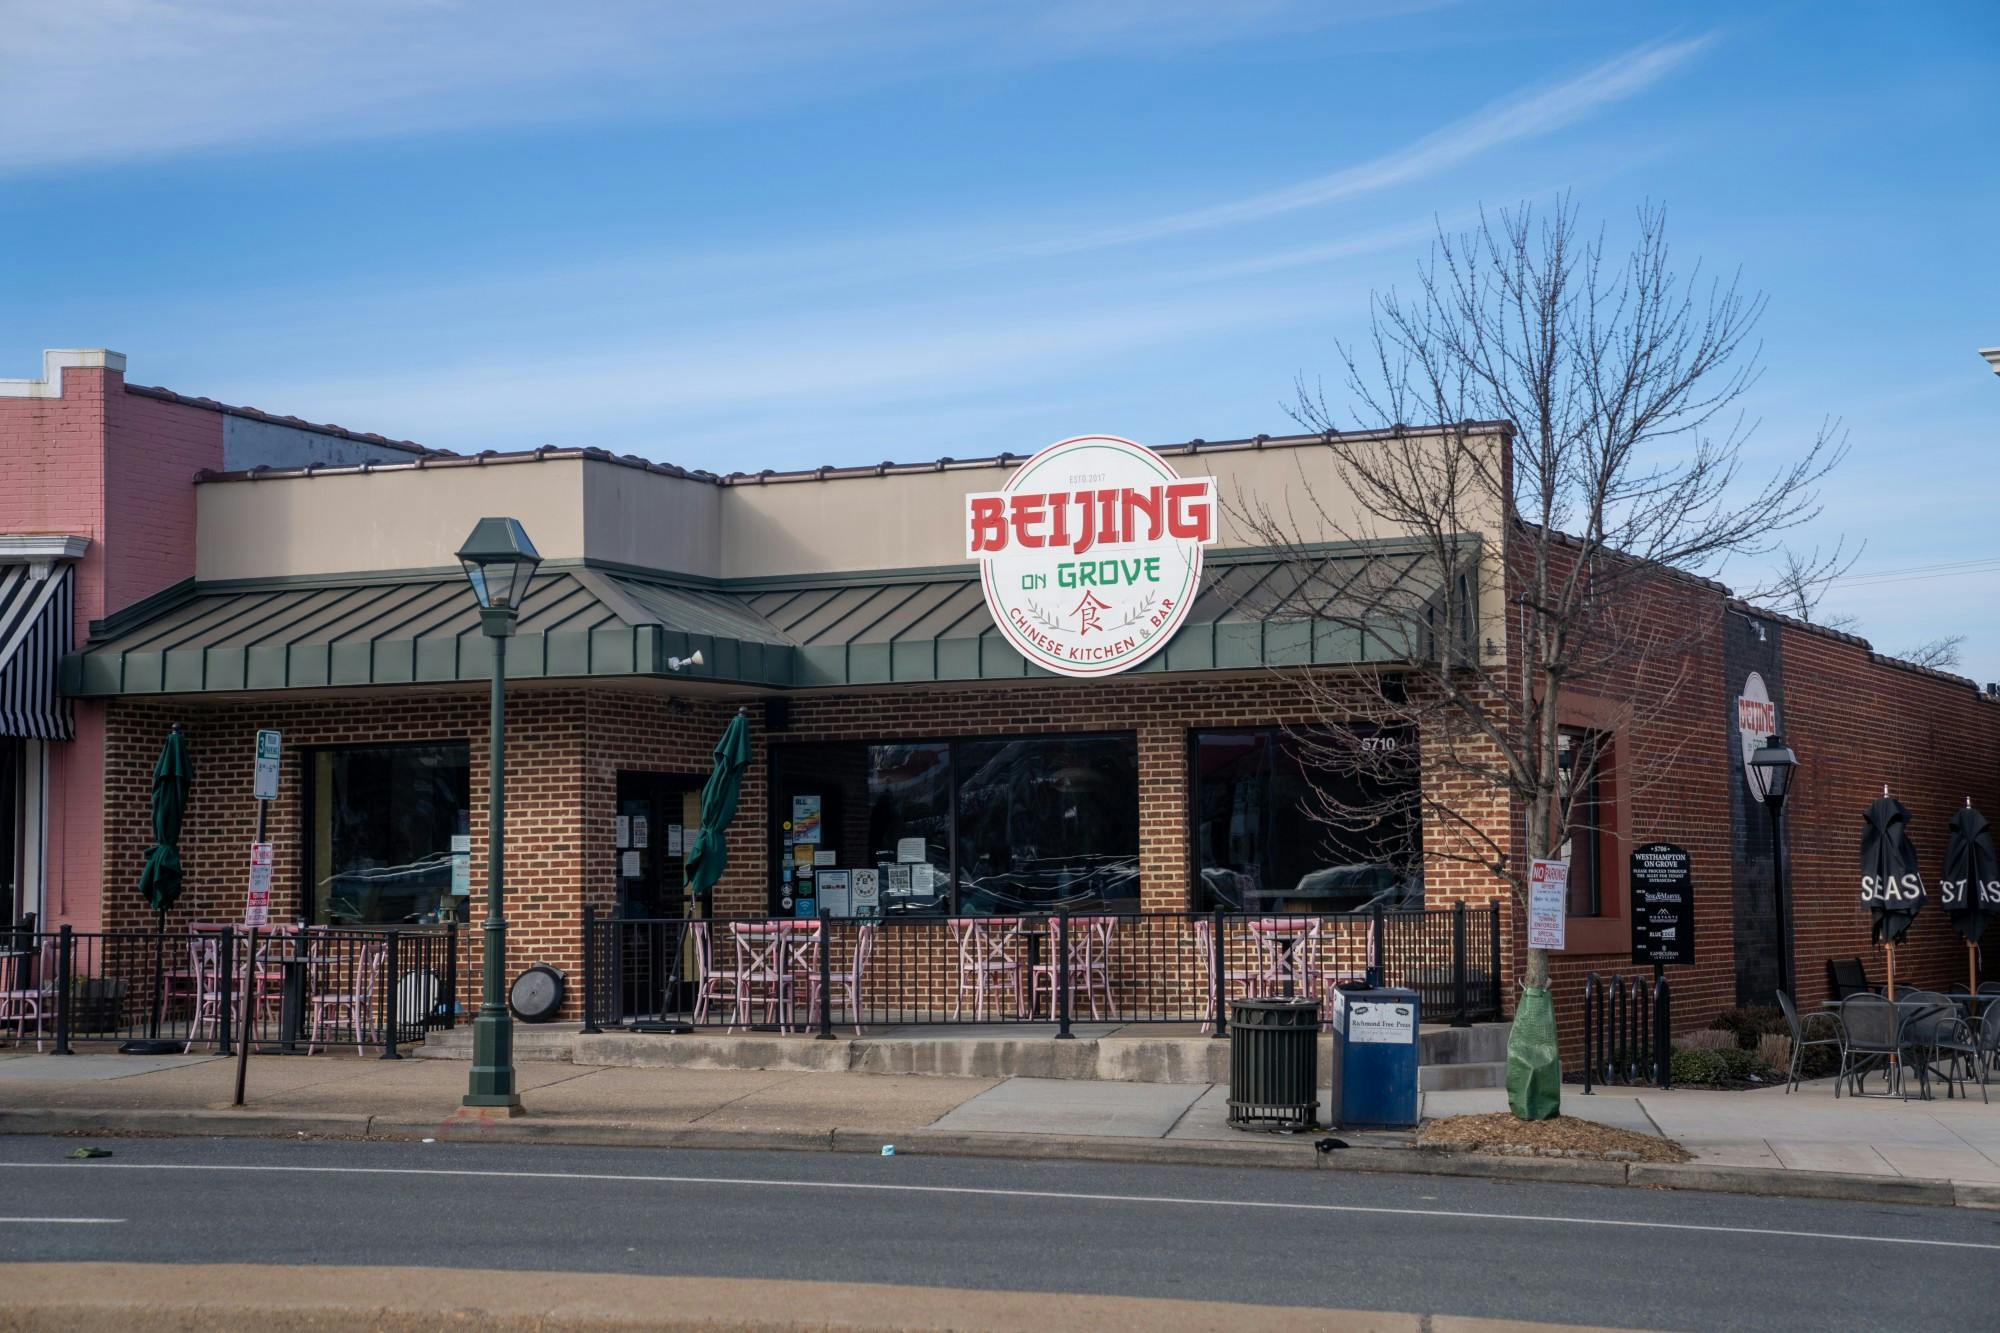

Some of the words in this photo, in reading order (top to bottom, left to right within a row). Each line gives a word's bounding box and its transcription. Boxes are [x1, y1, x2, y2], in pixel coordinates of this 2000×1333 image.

[971, 483, 1211, 555] BEIJING
[1022, 574, 1047, 590] ON
[1057, 557, 1160, 589] GROVE
[1010, 608, 1064, 656] CHINESE
[1069, 636, 1136, 660] KITCHEN
[1140, 628, 1150, 639] &
[1150, 599, 1174, 627] BAR
[1069, 590, 1112, 636] 食
[1740, 699, 1775, 735] BEIJING
[1362, 738, 1396, 751] 5710
[1533, 866, 1544, 880] NO
[1352, 1020, 1381, 1028] Richmond
